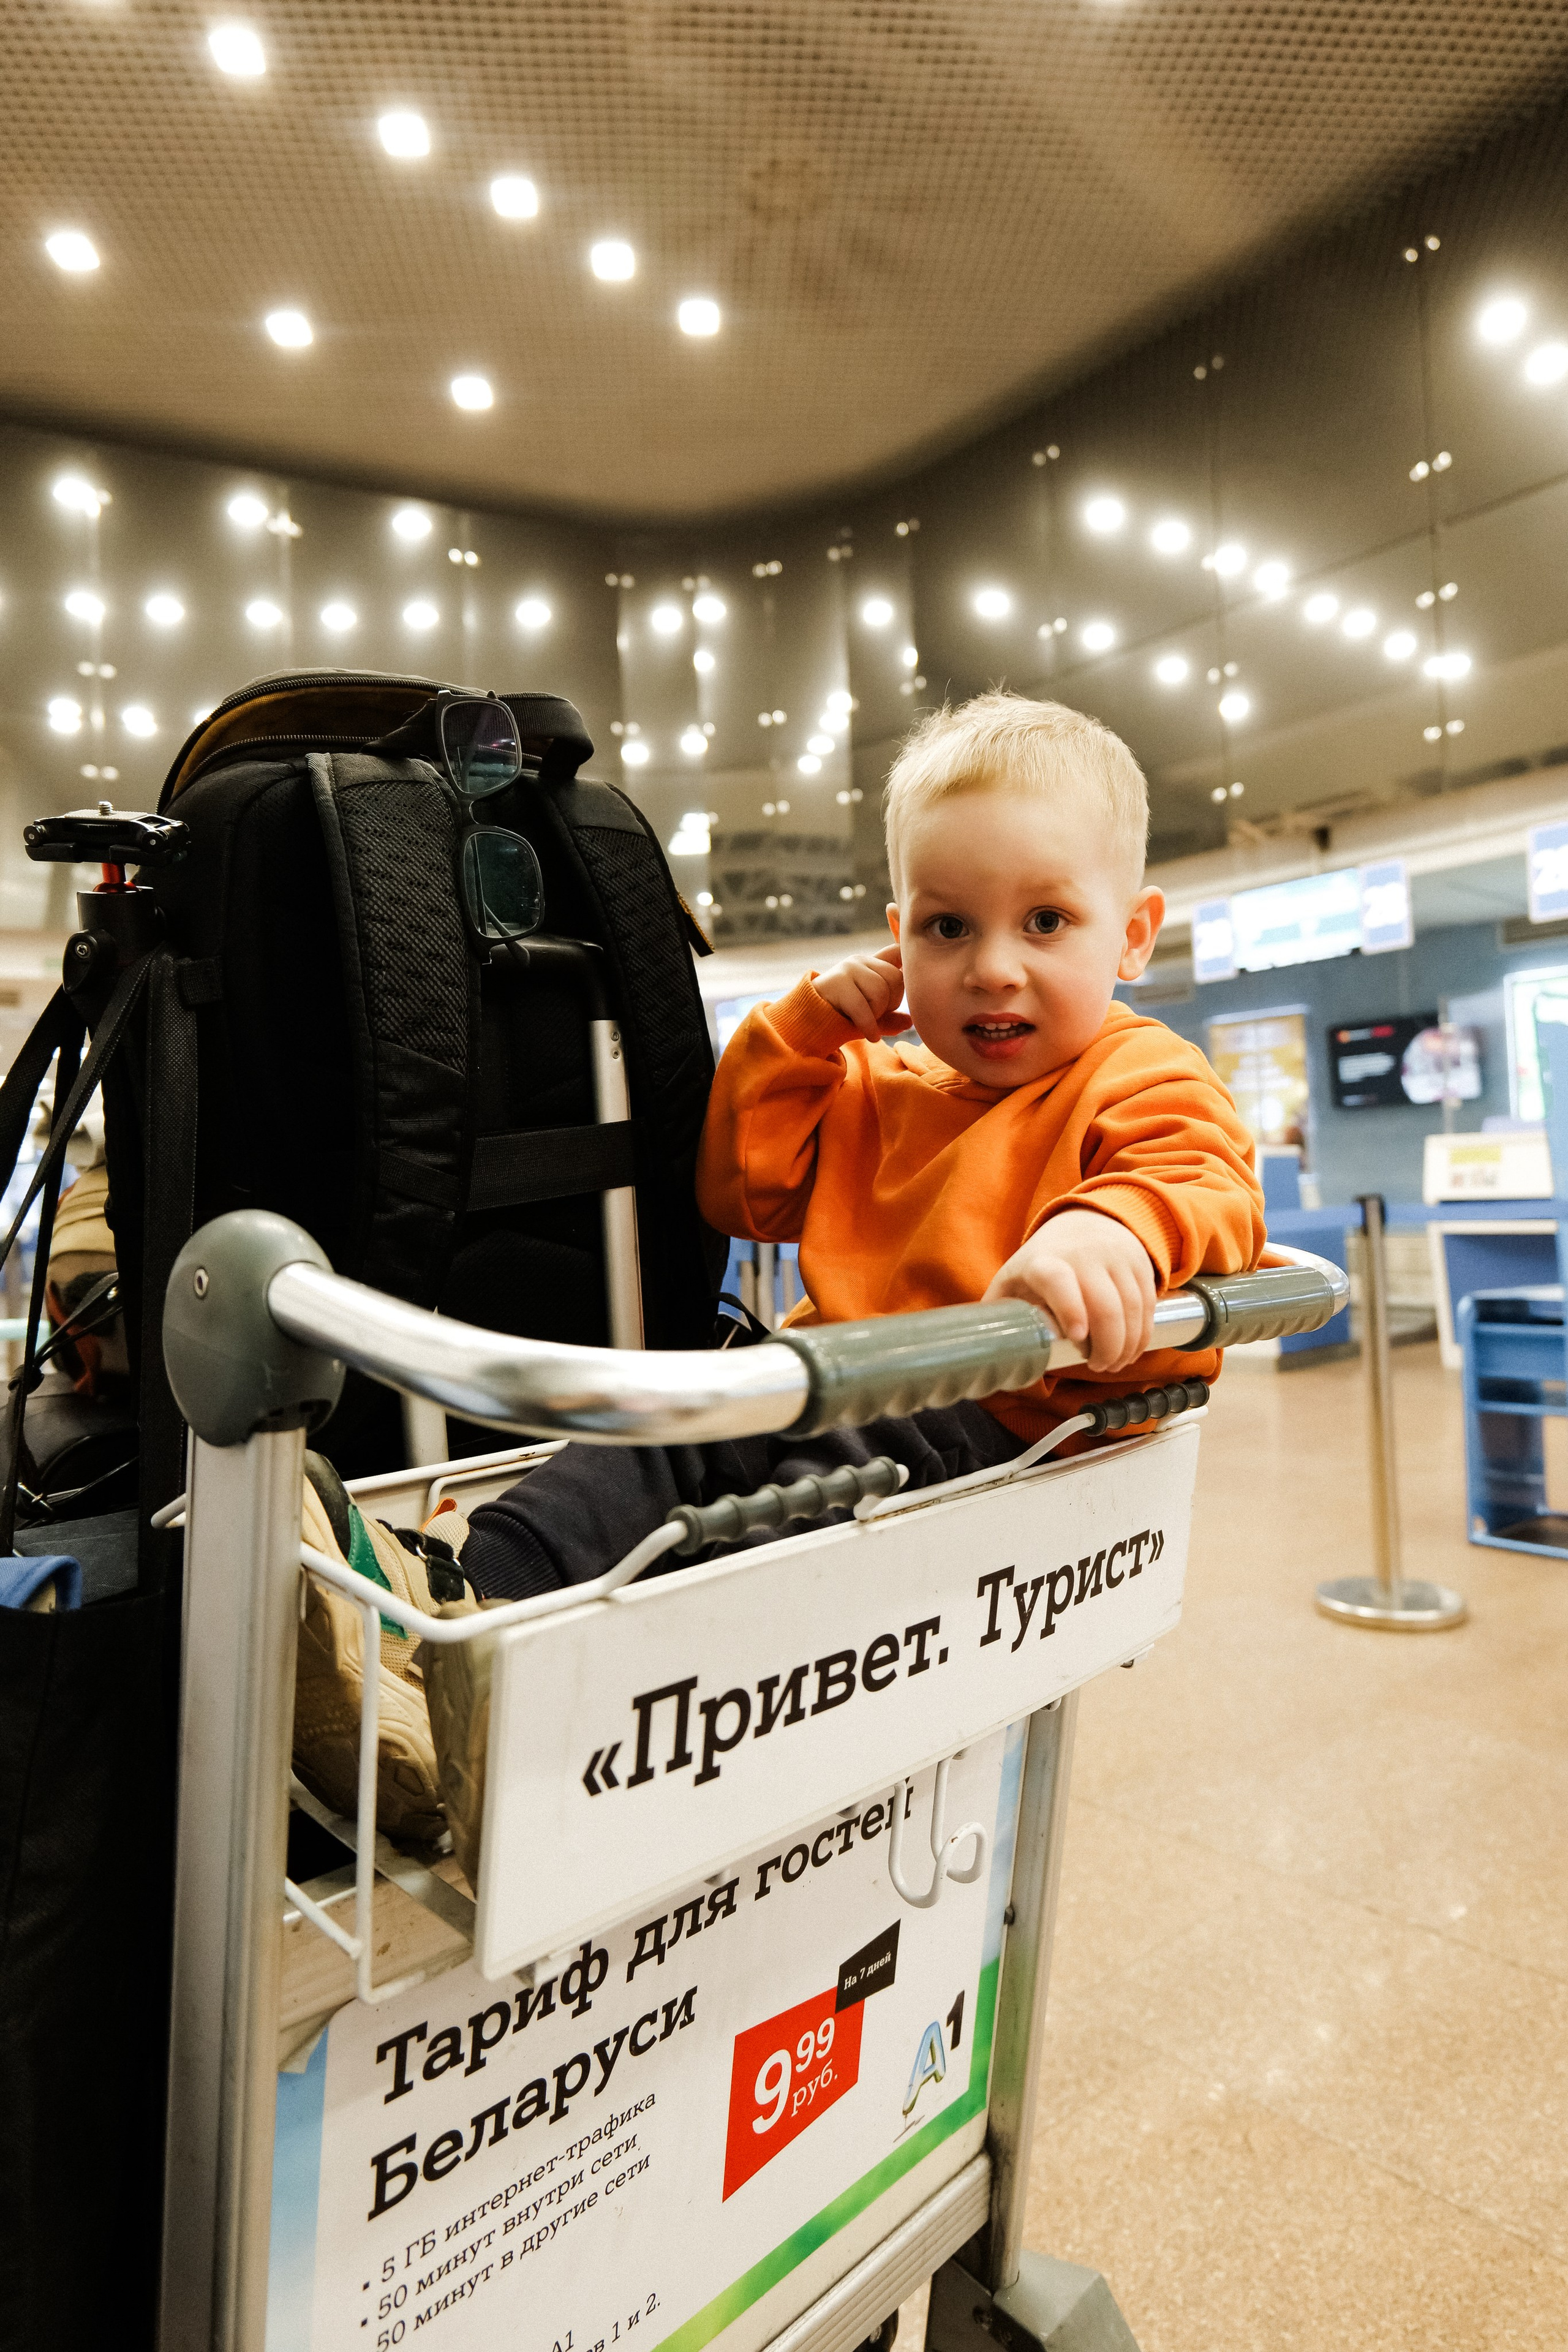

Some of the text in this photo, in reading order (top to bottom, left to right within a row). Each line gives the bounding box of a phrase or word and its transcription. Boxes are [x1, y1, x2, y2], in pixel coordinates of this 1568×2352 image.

[582, 1529, 1164, 1796] «Привет. Турист»
[375, 1939, 609, 2105] Тариф
[626, 1877, 740, 1983] для
[844, 1951, 891, 1990] На 7 дней
[368, 1985, 698, 2222] Беларуси
[791, 2059, 837, 2117] руб.
[377, 2154, 650, 2352] 50 минут в другие сети
[379, 2284, 407, 2320] 50
[416, 2229, 496, 2295] минут
[502, 2169, 584, 2236] внутри
[382, 2094, 656, 2282] 5 ГБ интернет-трафика
[612, 2293, 661, 2343] 1 и 2.
